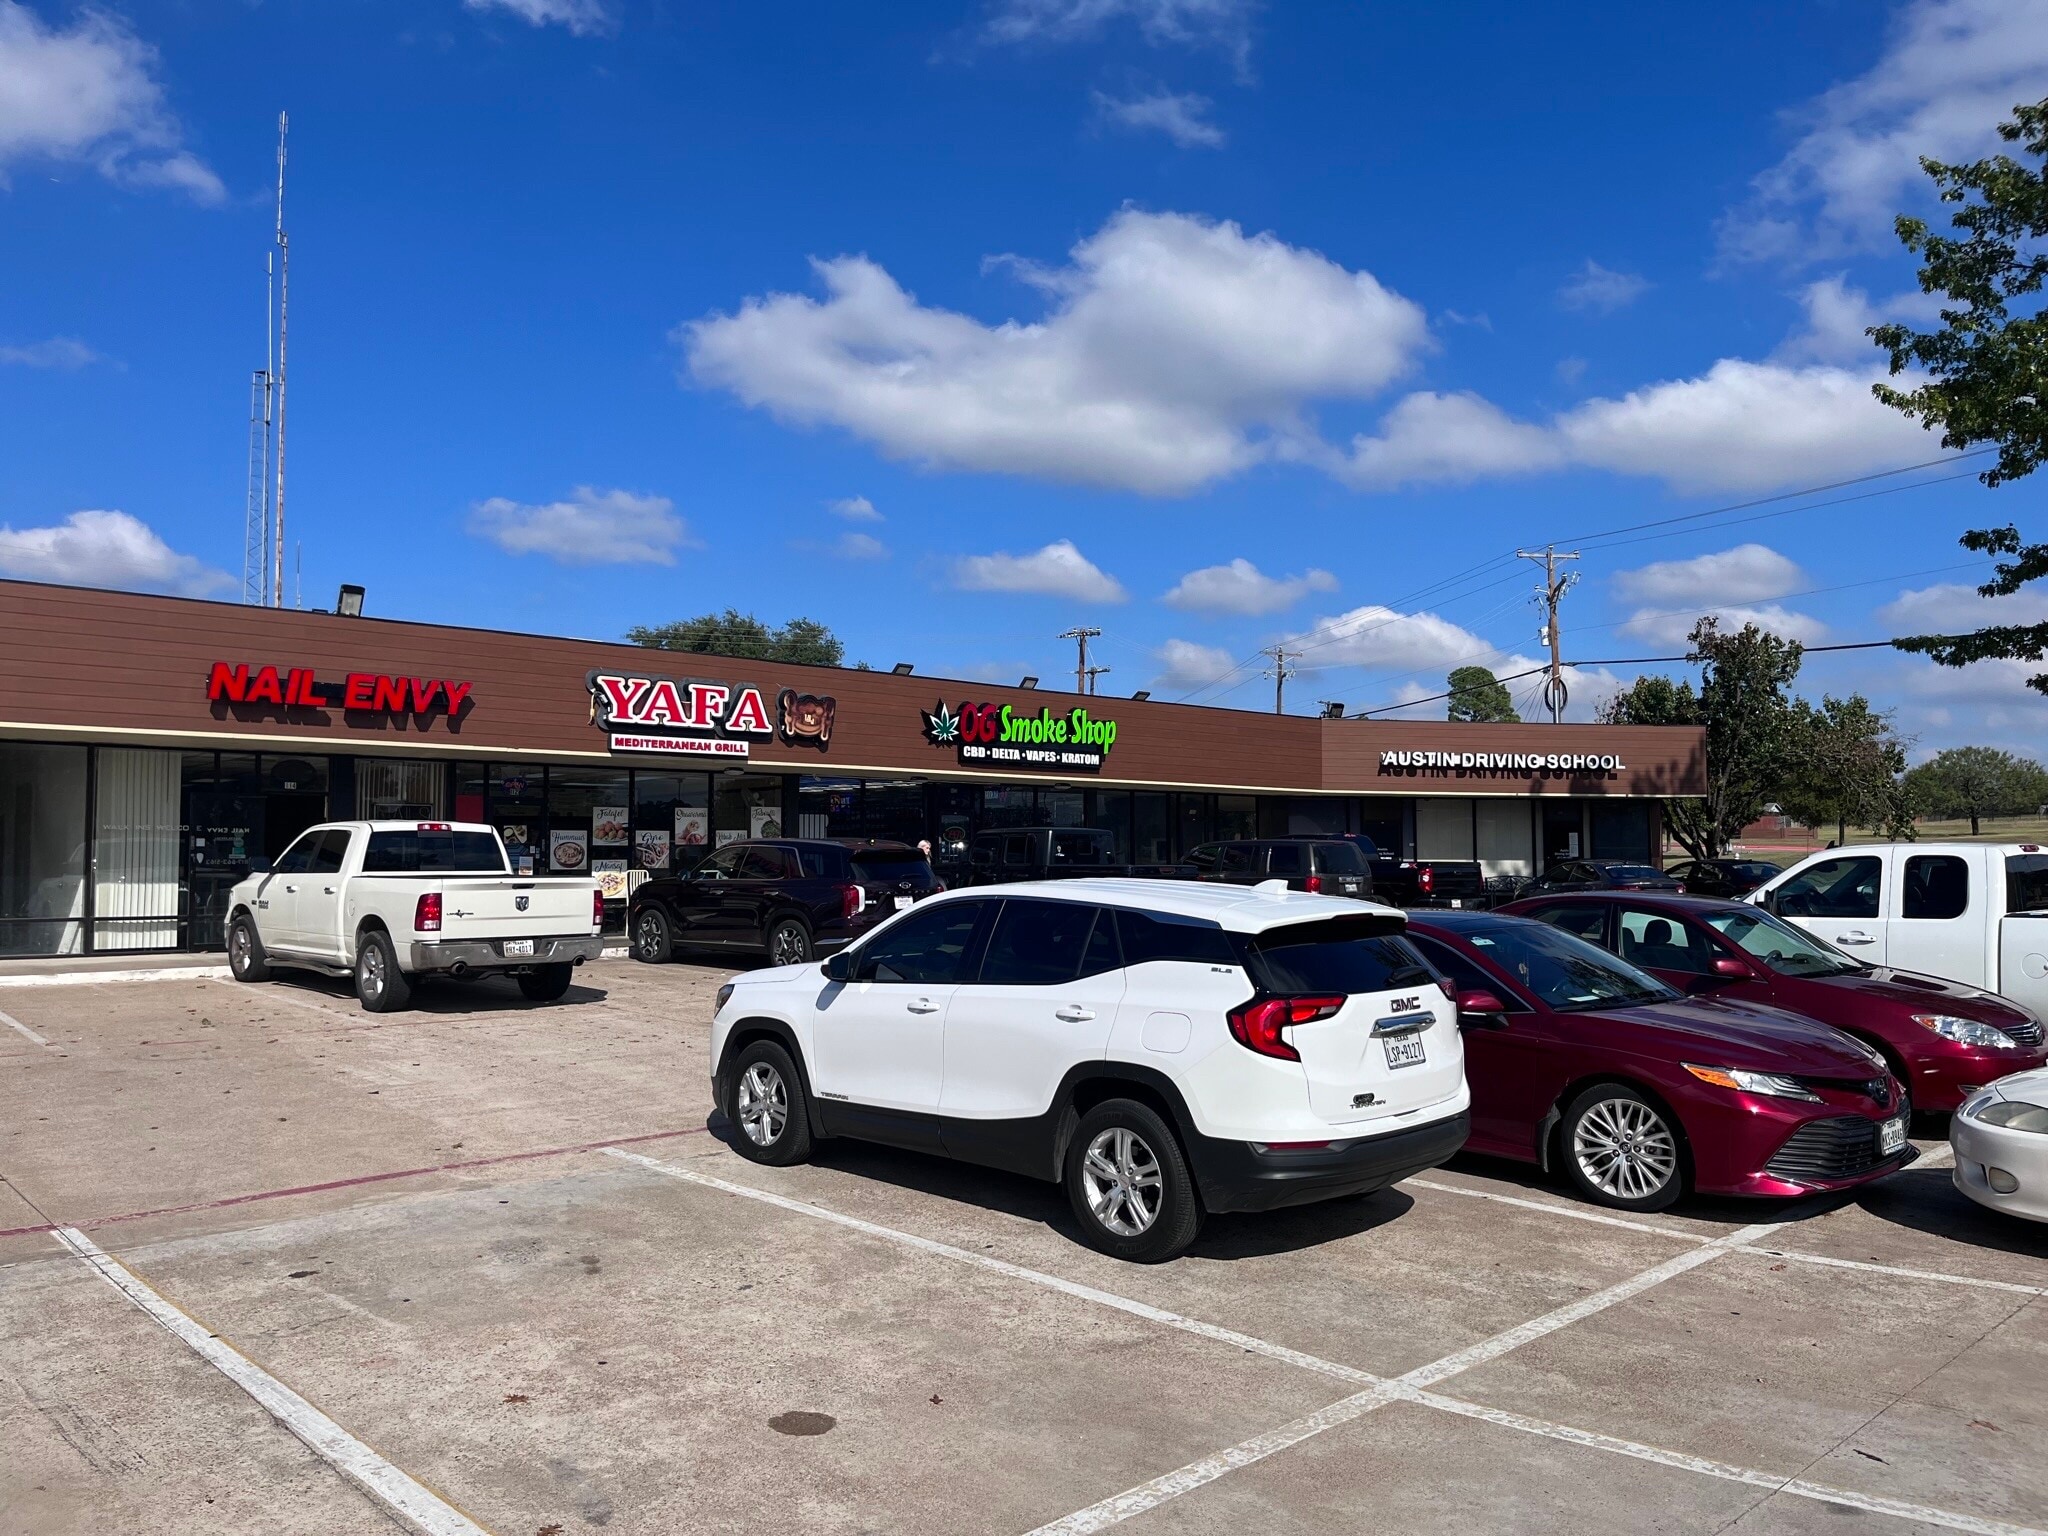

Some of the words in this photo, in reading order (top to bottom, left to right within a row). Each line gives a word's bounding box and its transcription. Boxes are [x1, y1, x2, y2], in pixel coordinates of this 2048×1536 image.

[207, 662, 326, 707] NAIL
[344, 673, 473, 715] ENVY
[597, 675, 773, 733] YAFA
[960, 703, 996, 742] OG
[1000, 705, 1067, 743] Smoke
[1071, 708, 1117, 754] Shop
[614, 737, 711, 751] MEDITERRANEAN
[715, 743, 746, 753] GRILL
[963, 745, 986, 758] CBD
[992, 748, 1020, 760] DELTA
[1026, 750, 1056, 762] VAPES
[1061, 753, 1100, 765] KRATOM
[1382, 751, 1455, 767] AUSTIN
[1461, 752, 1540, 769] DRIVING
[1546, 754, 1625, 770] SCHOOL
[597, 808, 624, 821] Falafel
[157, 824, 202, 832] WELCOE
[641, 832, 664, 844] Gyro
[1390, 996, 1421, 1013] GMC
[1394, 1034, 1409, 1042] TEXAS
[820, 1091, 849, 1100] TERRAIN
